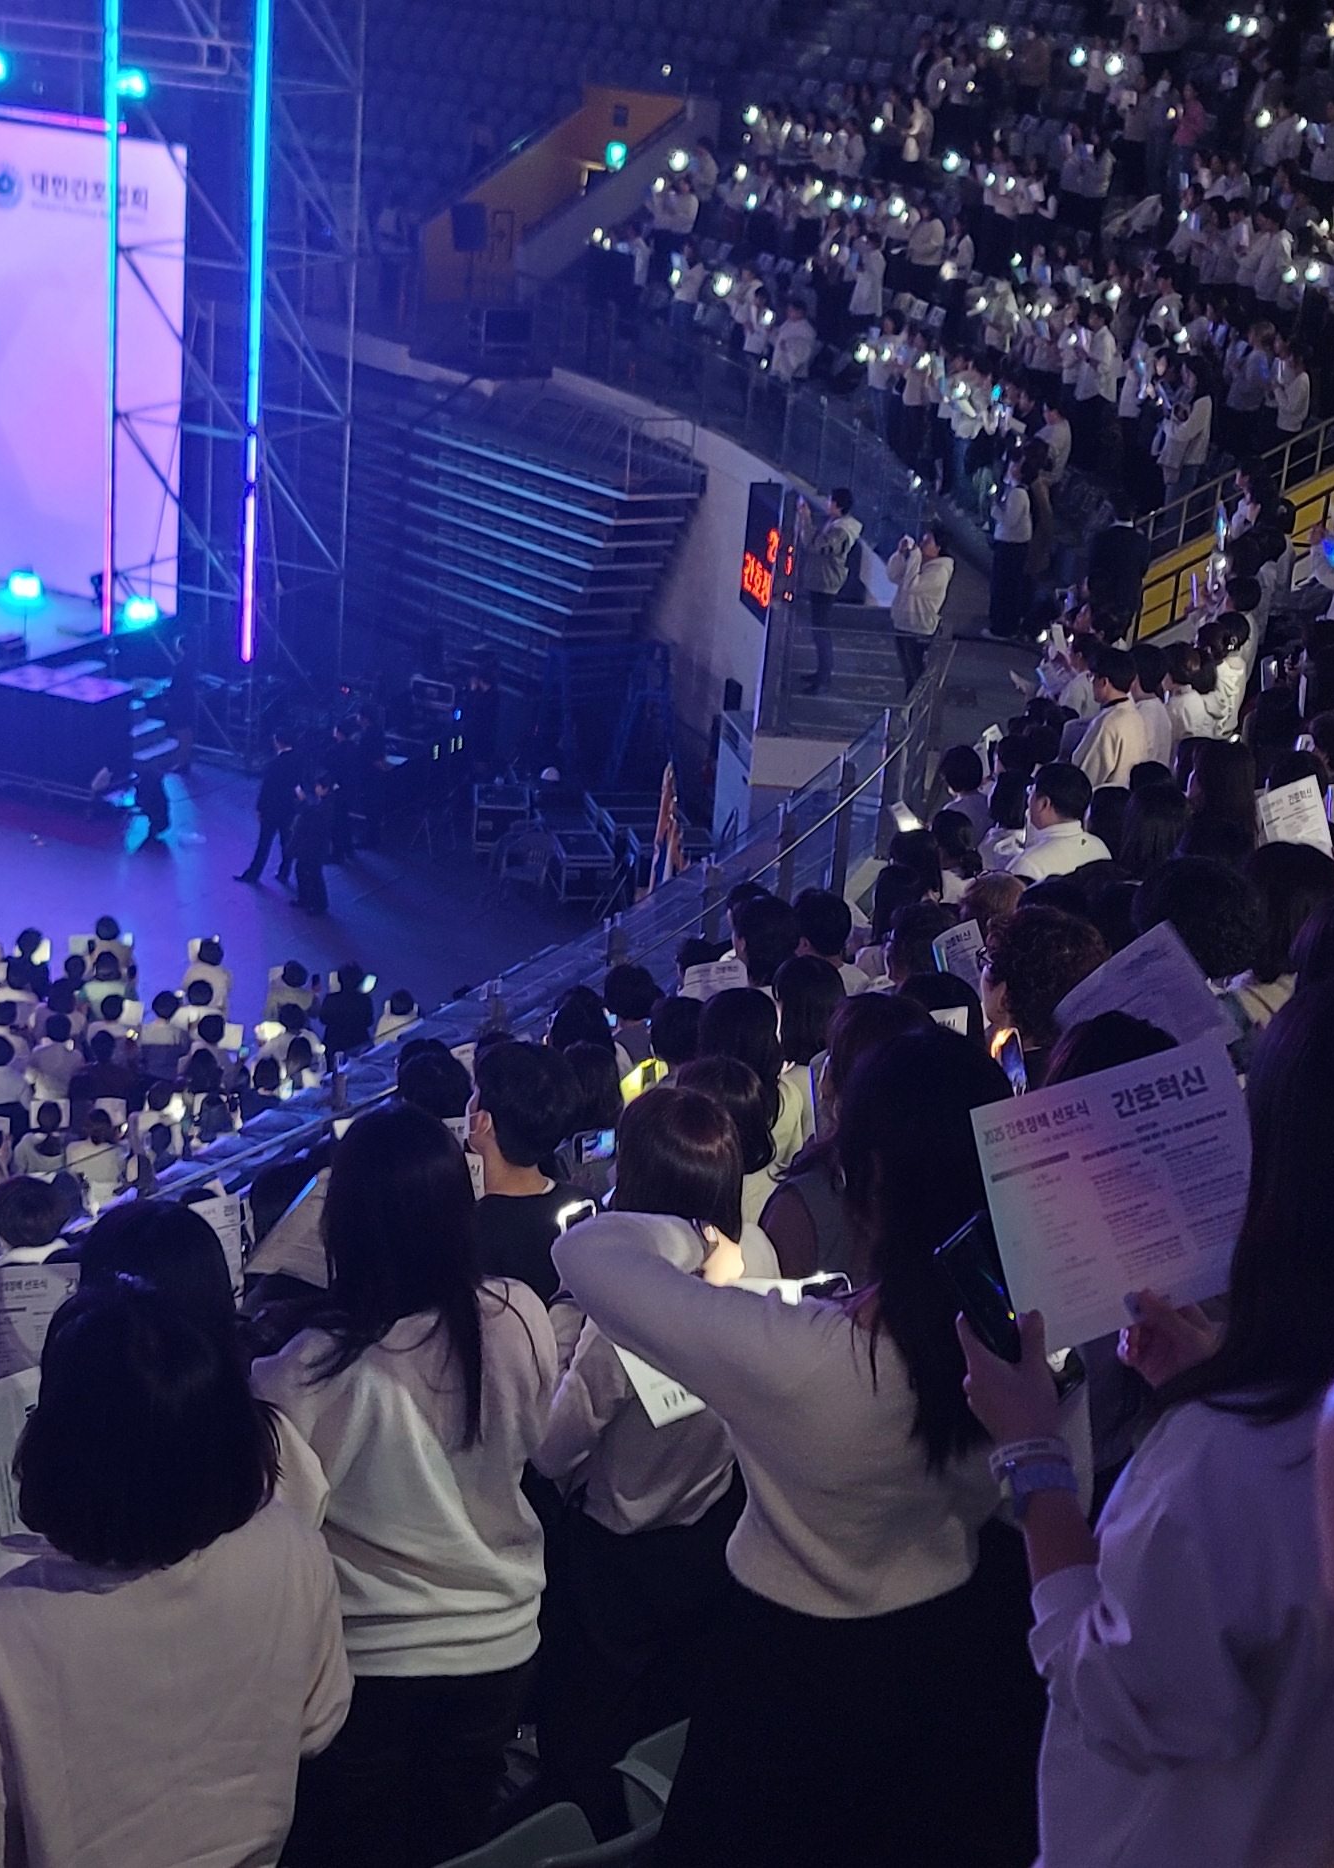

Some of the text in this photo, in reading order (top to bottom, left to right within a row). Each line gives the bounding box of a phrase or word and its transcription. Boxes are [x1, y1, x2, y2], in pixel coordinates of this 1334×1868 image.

[1110, 1065, 1209, 1120] 간호혁신
[1005, 1111, 1051, 1140] 간호정책
[1052, 1099, 1091, 1126] 선포식
